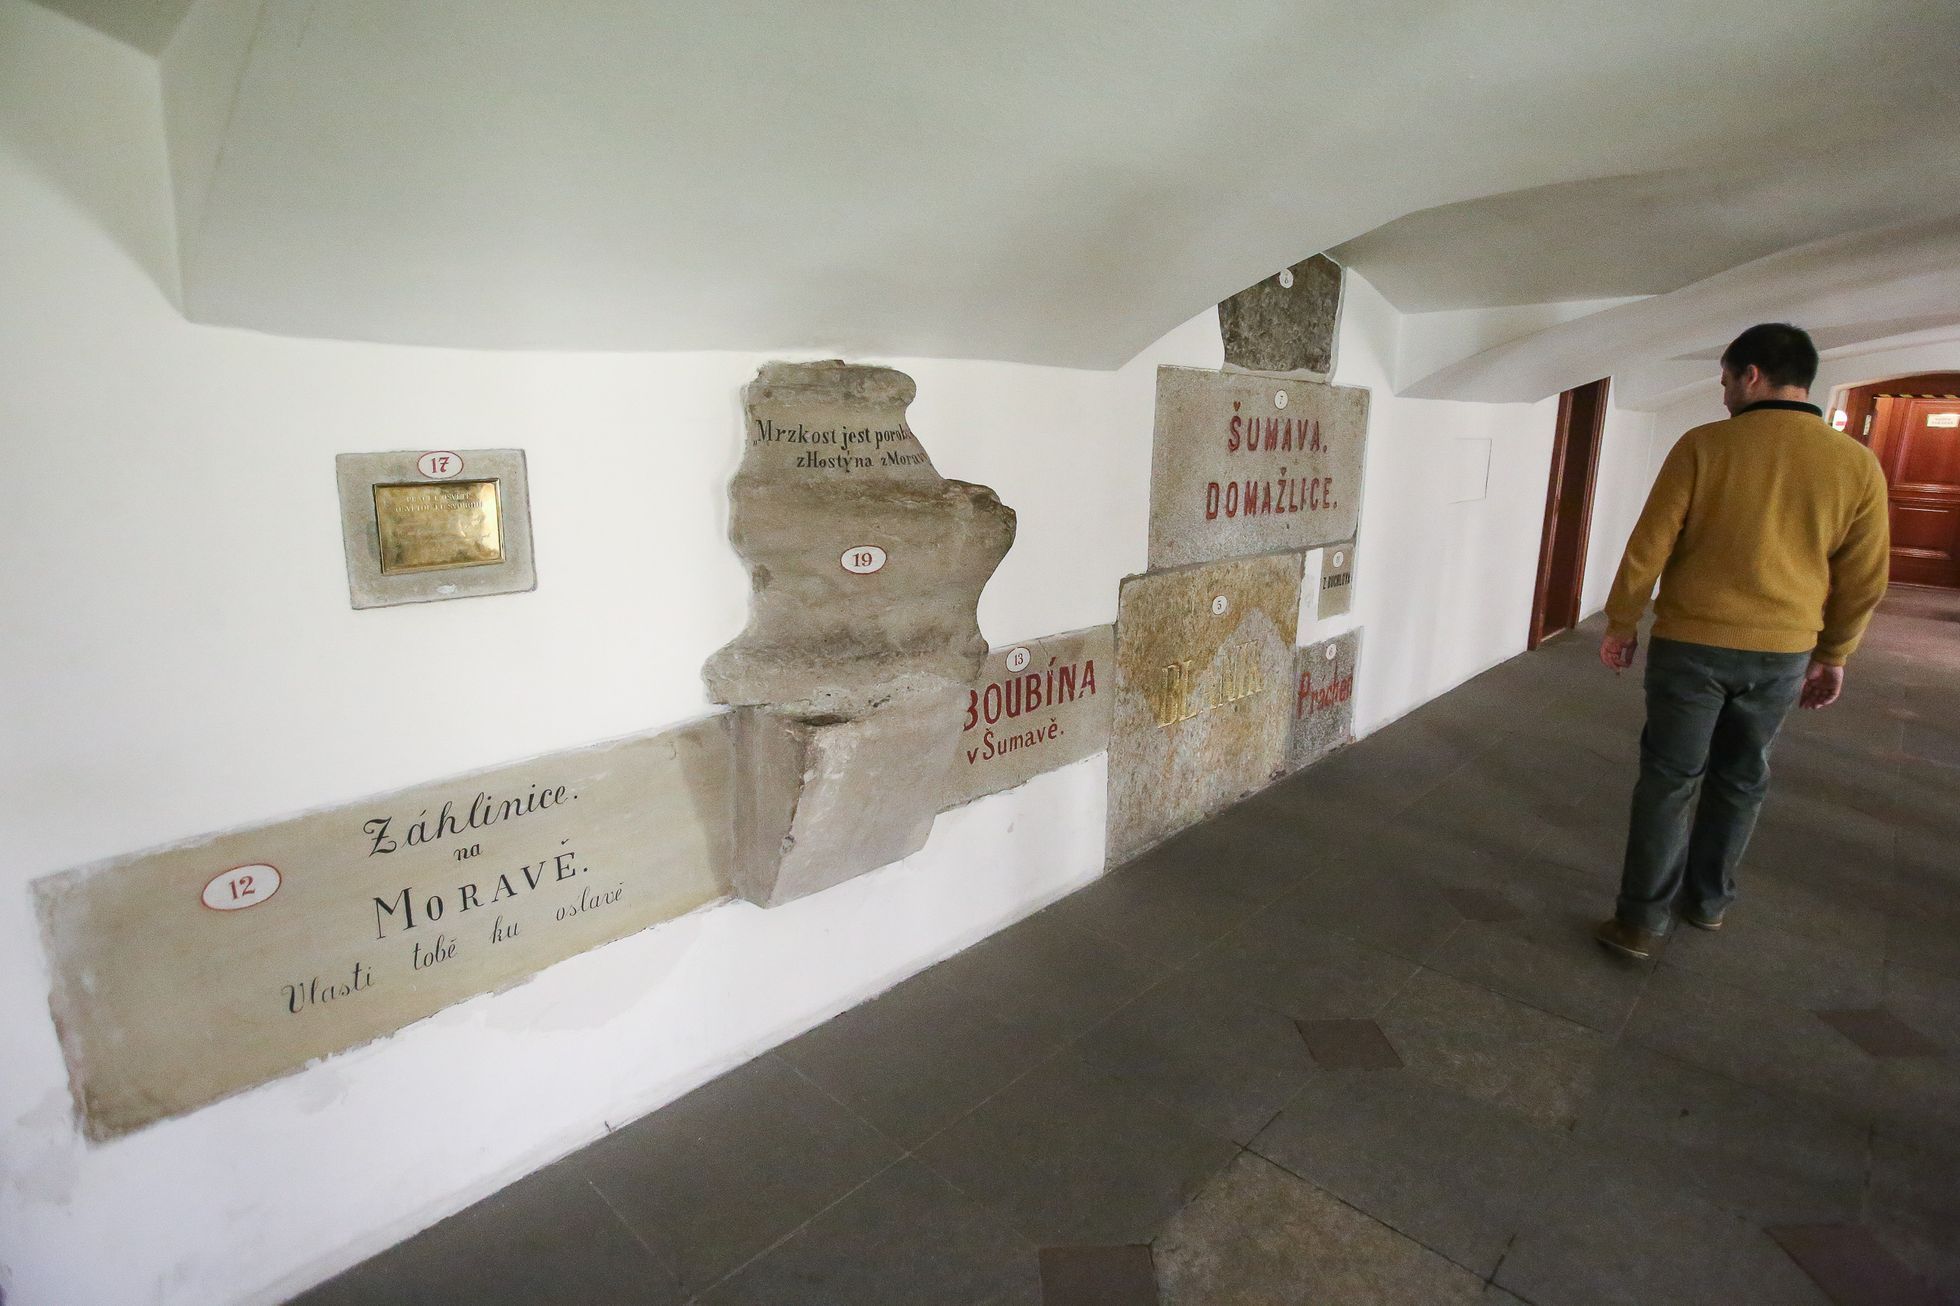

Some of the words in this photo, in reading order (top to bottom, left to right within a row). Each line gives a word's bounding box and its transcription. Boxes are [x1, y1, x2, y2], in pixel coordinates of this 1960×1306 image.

[840, 426, 872, 450] jest
[1227, 400, 1328, 453] ŠUMAVA.
[431, 456, 450, 473] 17
[1205, 466, 1337, 520] DOMAŽLICE.
[853, 552, 873, 567] 19
[1014, 653, 1024, 666] 13
[363, 784, 578, 857] Záhlinice.
[453, 843, 482, 861] na
[229, 875, 256, 900] 12
[491, 914, 521, 944] ku
